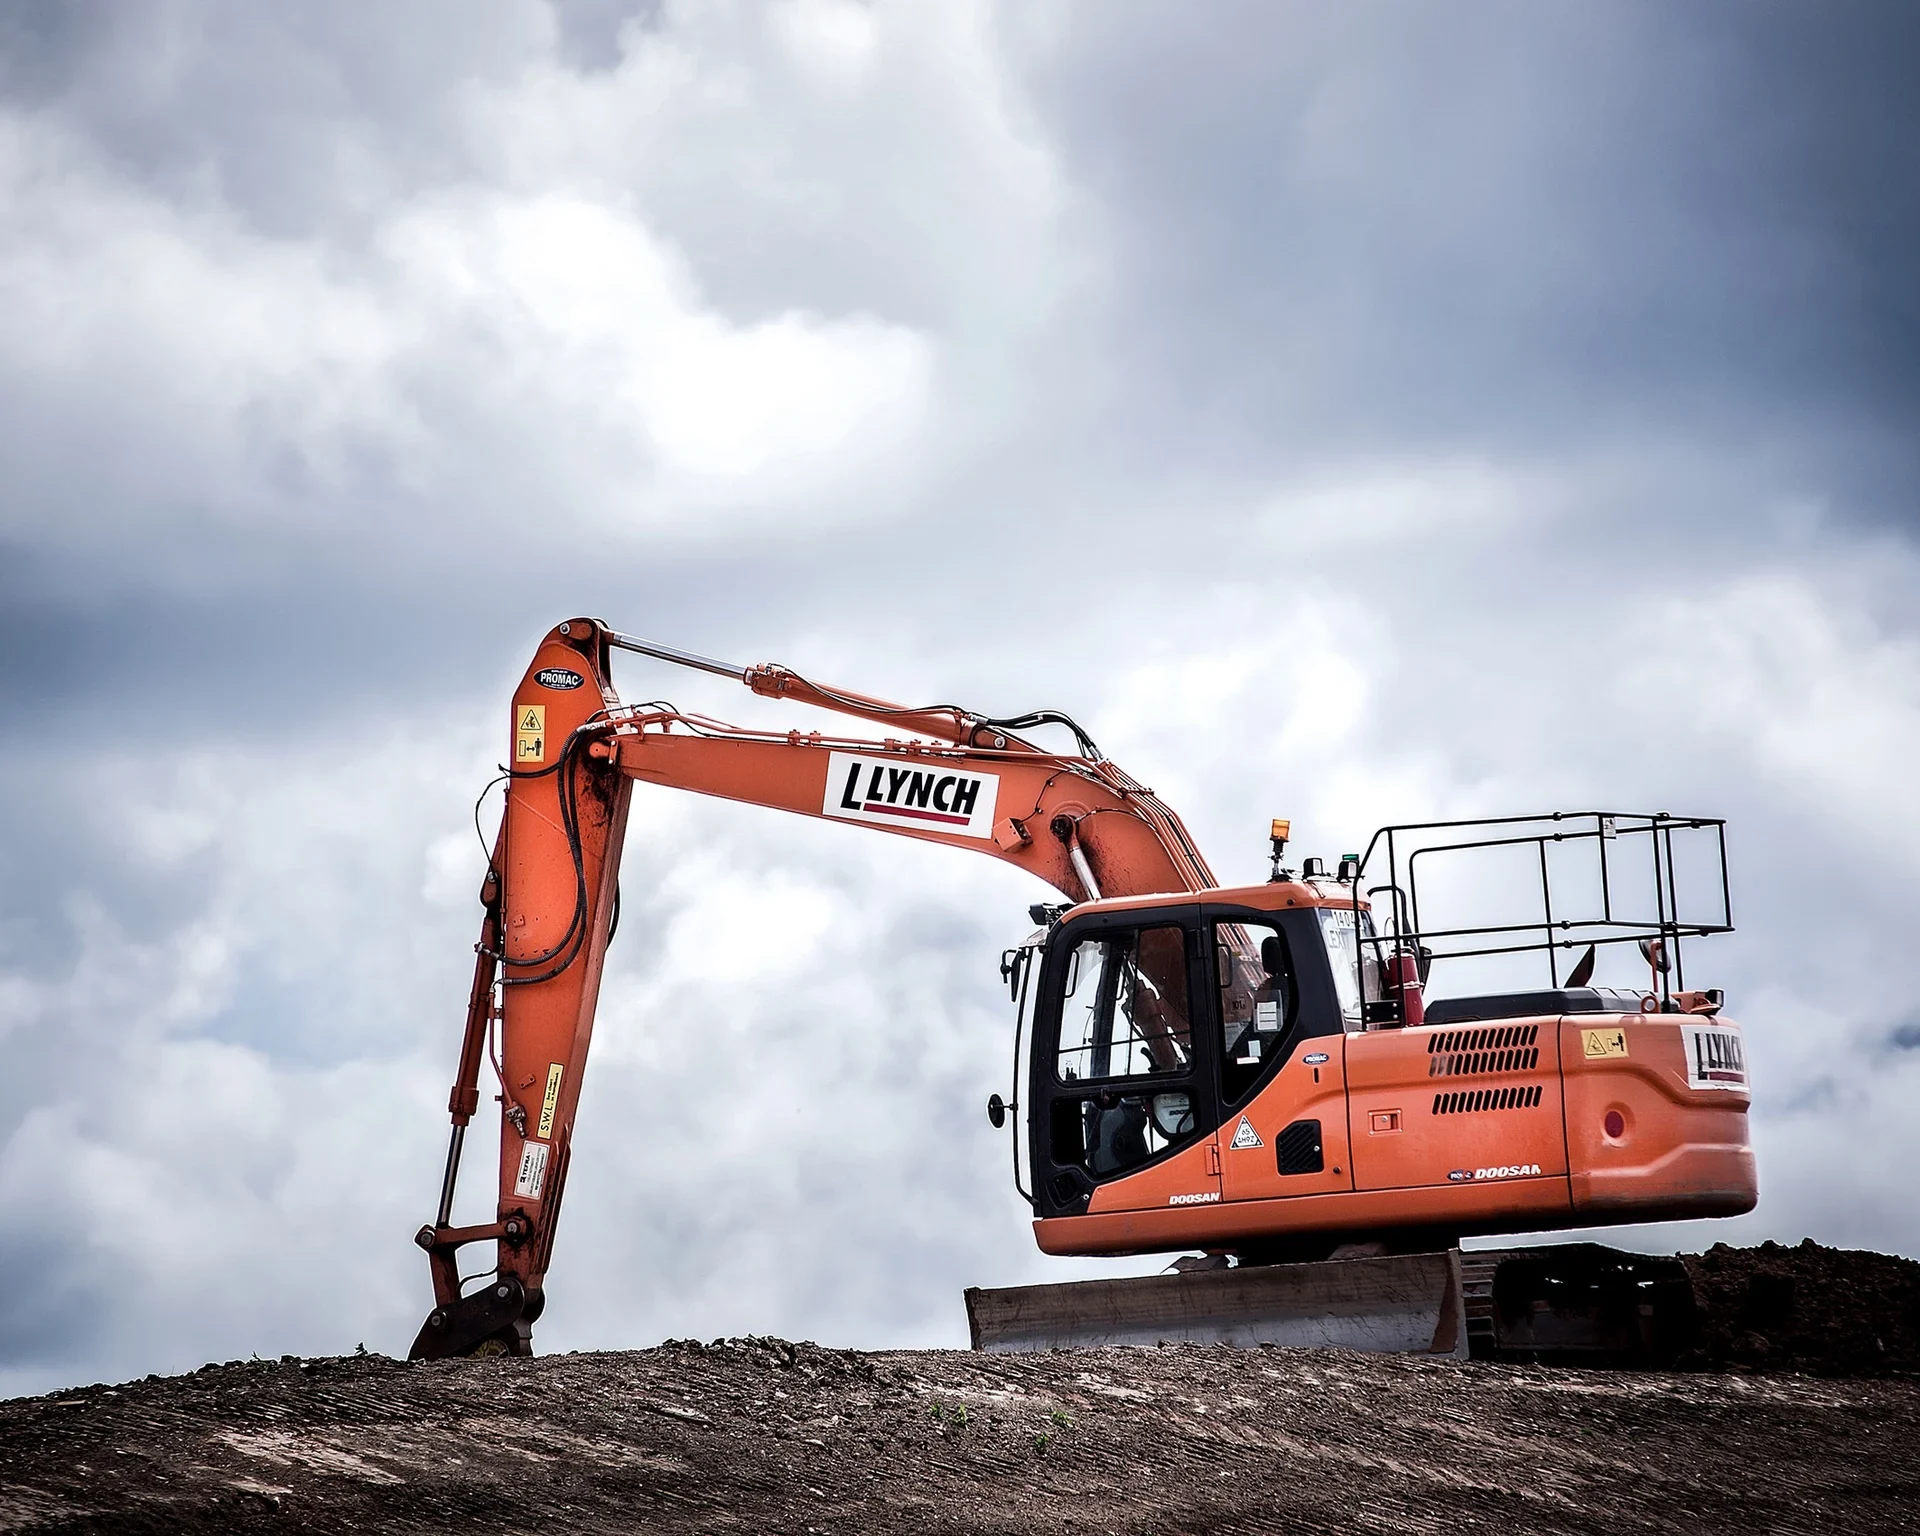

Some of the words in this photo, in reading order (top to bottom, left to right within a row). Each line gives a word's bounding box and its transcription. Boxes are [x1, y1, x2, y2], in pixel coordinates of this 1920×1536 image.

[541, 672, 578, 686] PROMAC
[541, 1103, 553, 1131] S.W.L.
[1169, 1192, 1220, 1205] DOOSAN
